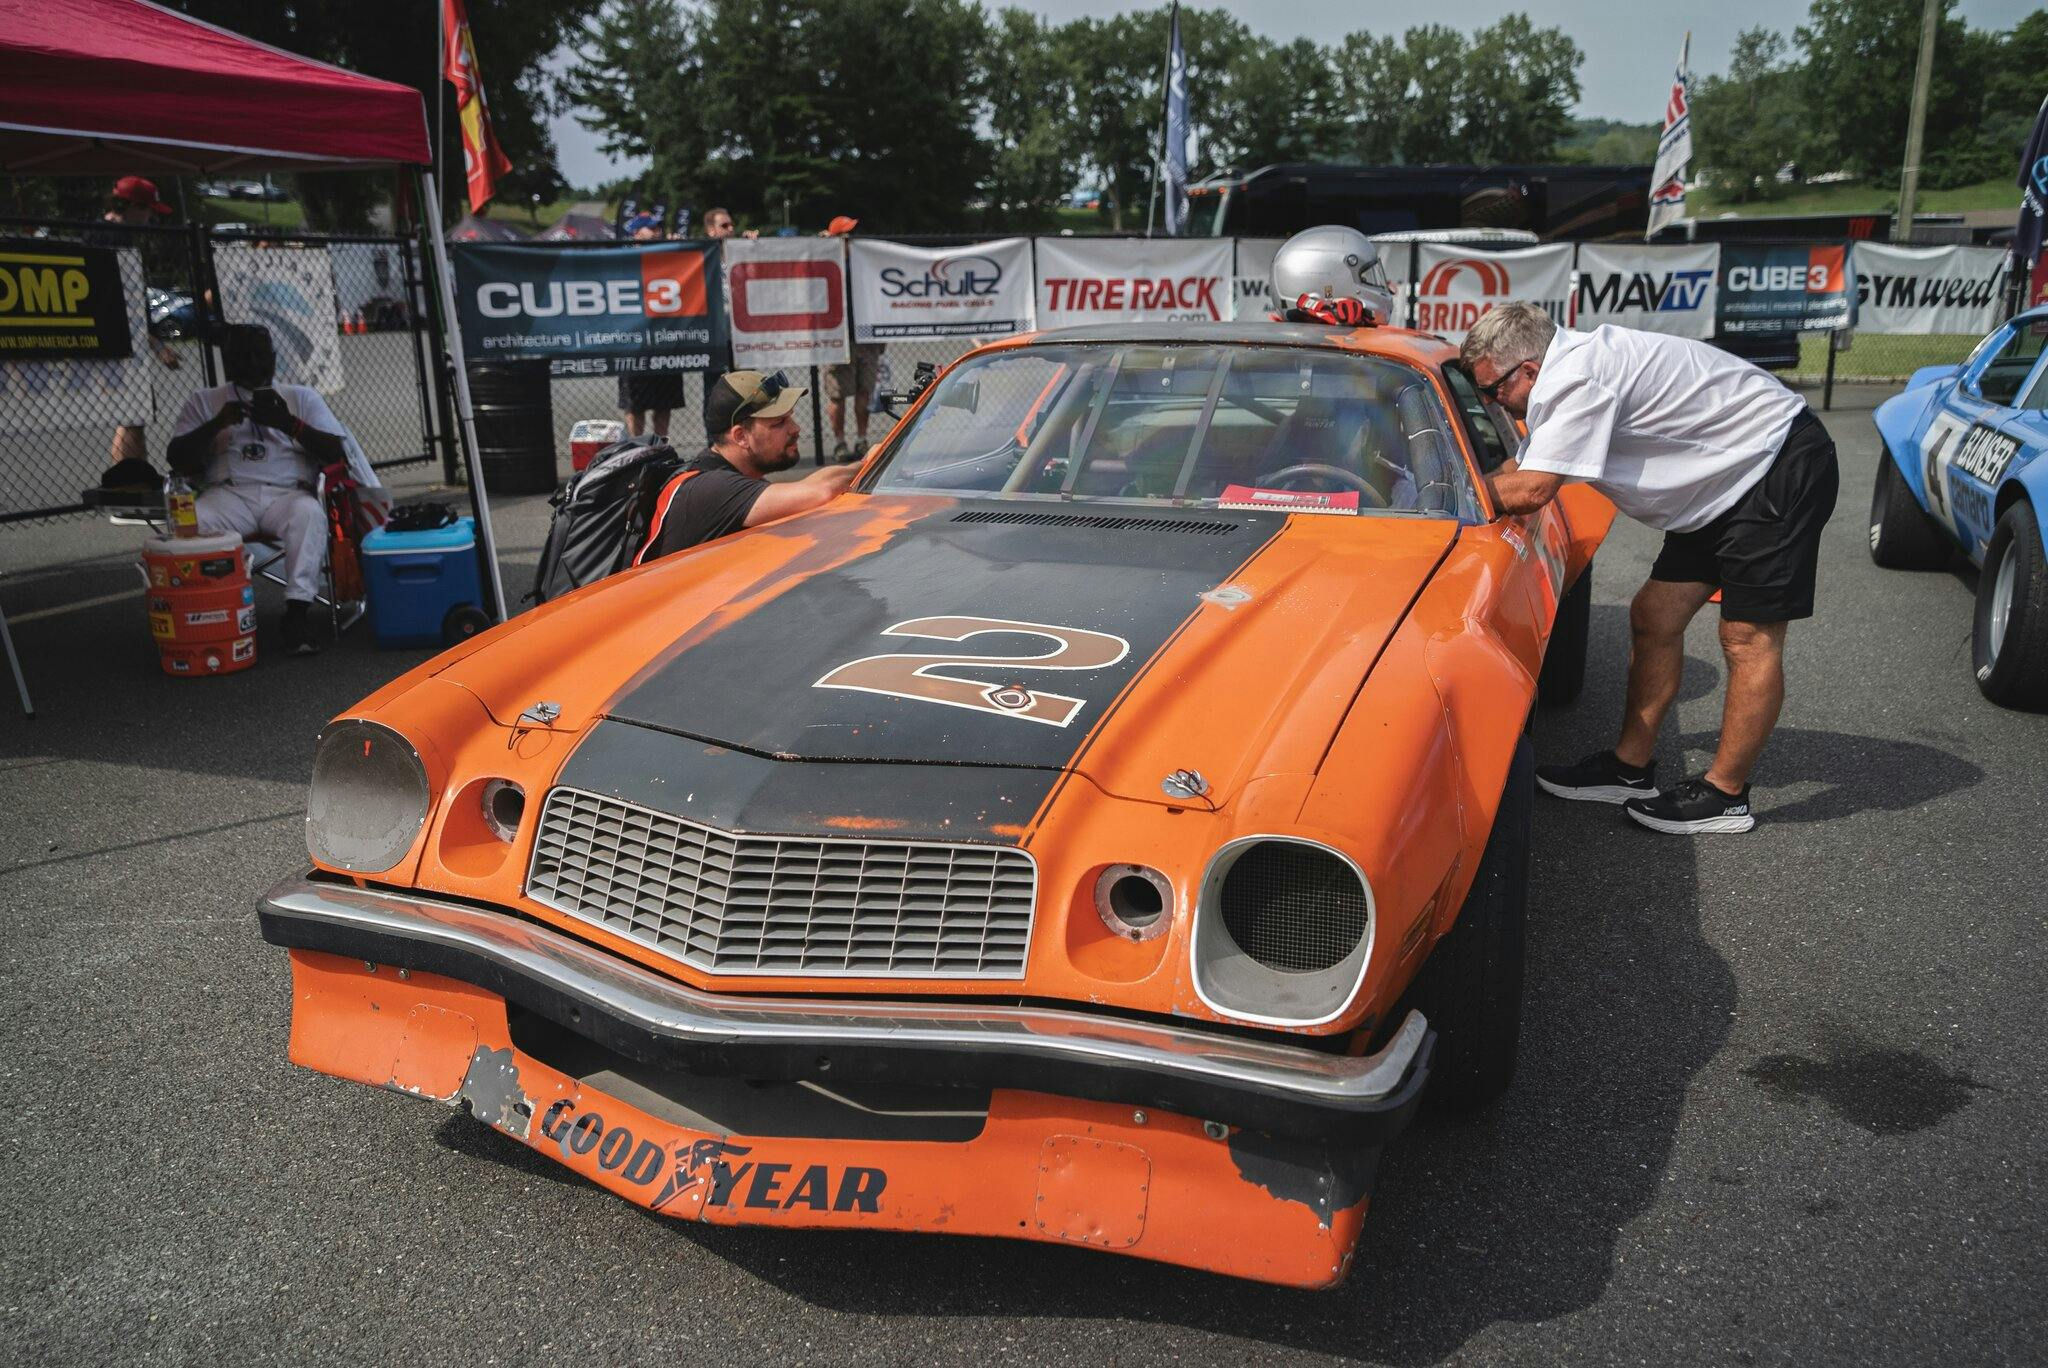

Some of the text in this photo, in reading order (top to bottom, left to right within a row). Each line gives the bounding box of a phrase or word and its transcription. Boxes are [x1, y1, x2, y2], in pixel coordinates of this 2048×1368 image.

[881, 266, 1000, 297] Schultz
[1578, 270, 1713, 313] MAVTV
[1727, 264, 1828, 292] CUBE3
[1919, 263, 2003, 309] weed
[476, 278, 682, 318] CUBE3
[1044, 276, 1221, 322] TIRE RACK
[482, 328, 710, 349] architecture interiors planning
[1804, 314, 1848, 330] SPONSOR
[549, 354, 710, 374] ERIES TITLE SPONSOR
[811, 615, 1131, 729] 2
[1723, 804, 1749, 817] HOKA
[541, 1099, 889, 1214] GOOD YEAR
